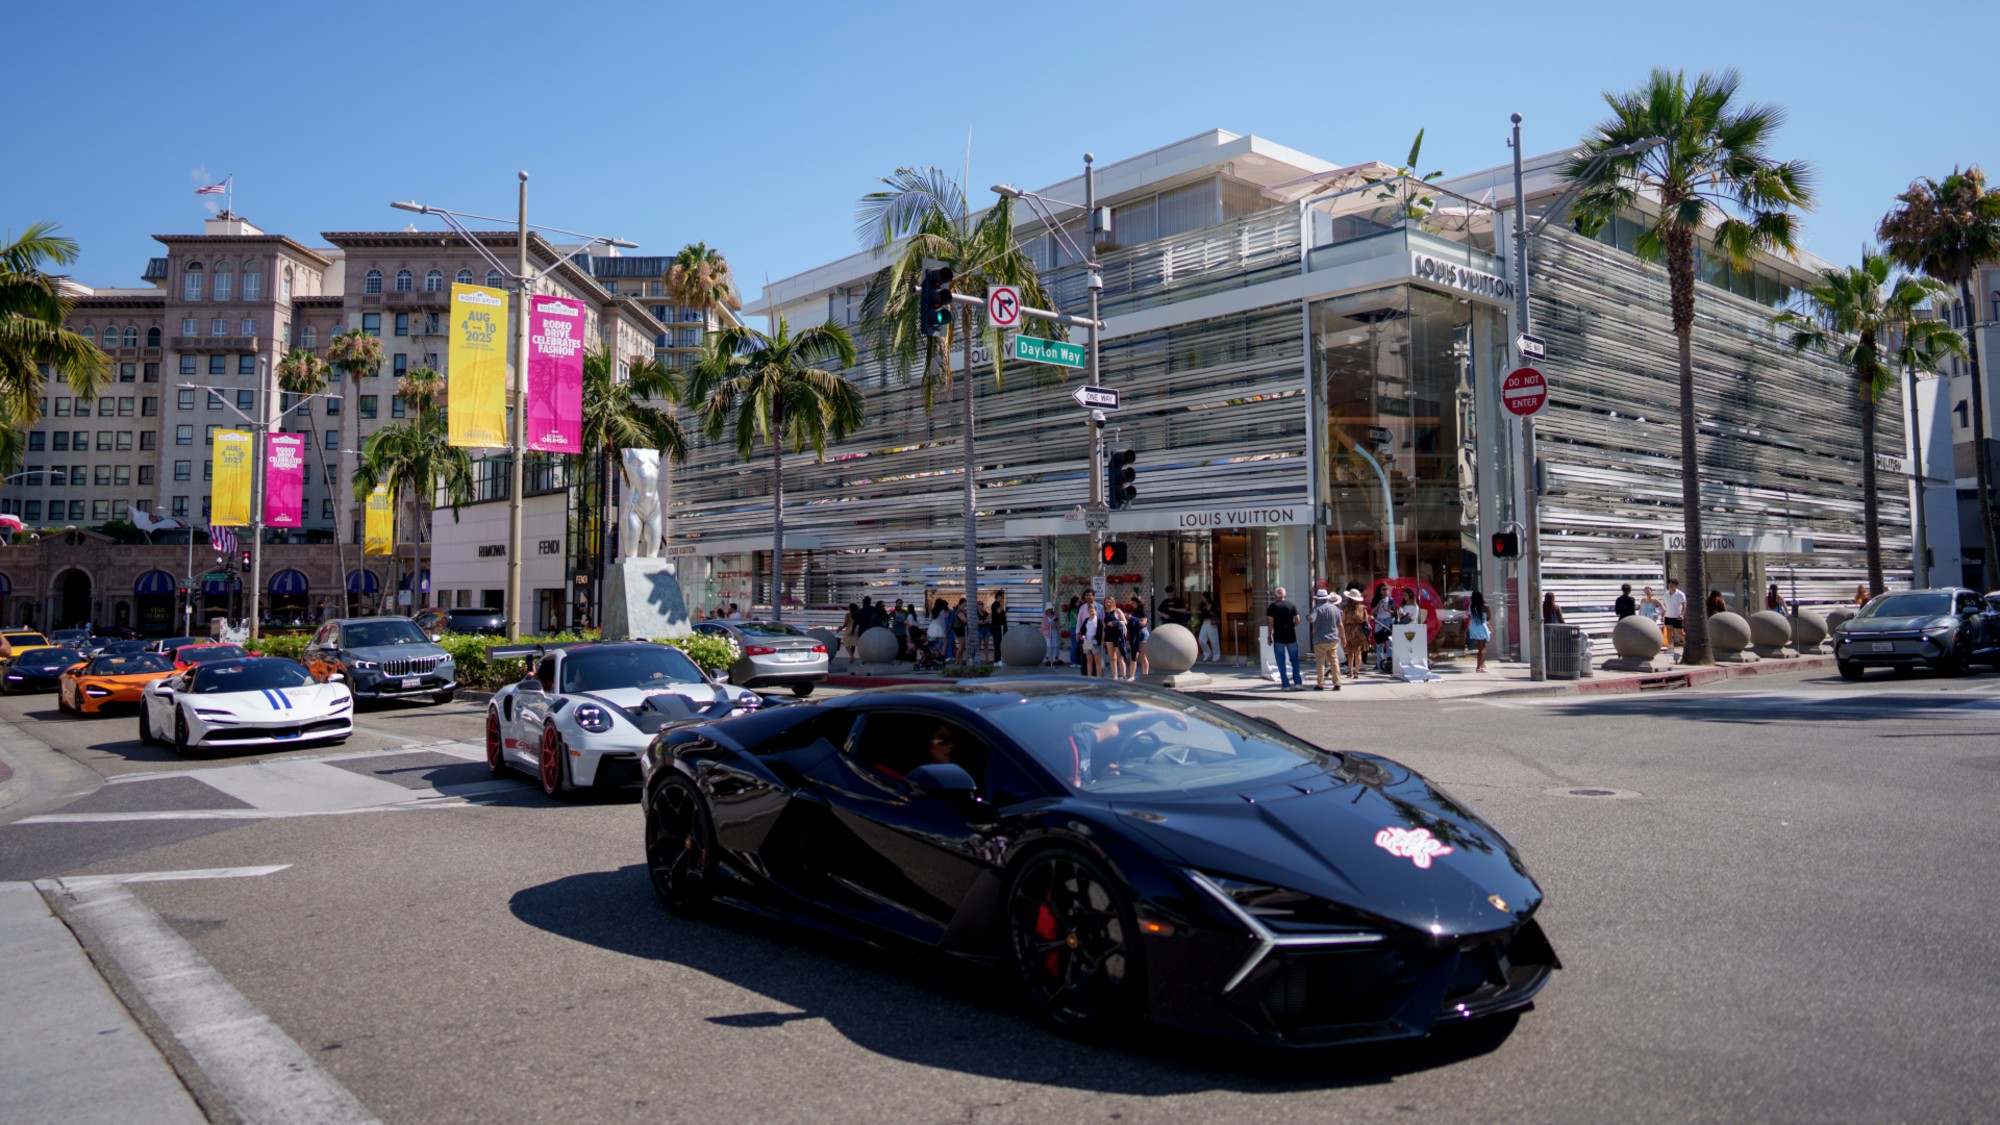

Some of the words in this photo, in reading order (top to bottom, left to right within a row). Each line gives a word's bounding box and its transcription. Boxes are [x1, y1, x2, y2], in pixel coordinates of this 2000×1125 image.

[1416, 255, 1456, 284] LOUIS
[1459, 269, 1514, 299] VUITTON
[460, 294, 480, 303] RODEO
[481, 297, 499, 305] DRIVE
[468, 311, 490, 322] AUG
[461, 320, 469, 331] 4
[485, 323, 496, 334] 10
[542, 319, 572, 331] RODEO
[465, 331, 492, 343] 2025
[544, 329, 570, 339] DRIVE
[532, 335, 581, 349] CELEBRATES
[538, 344, 575, 356] FASHION
[1021, 341, 1057, 359] Dayton
[1060, 348, 1081, 365] Way
[1508, 378, 1520, 387] DO
[1524, 375, 1539, 385] NOT
[1086, 392, 1099, 401] ONE
[1100, 394, 1114, 403] WAY
[1512, 398, 1538, 408] ENTER
[1180, 512, 1221, 527] LOUIS
[1227, 509, 1293, 525] VUITTON
[478, 544, 506, 557] RIMOWA
[538, 540, 560, 555] FENDI
[1701, 537, 1735, 549] UITTON
[576, 575, 588, 584] FENDI
